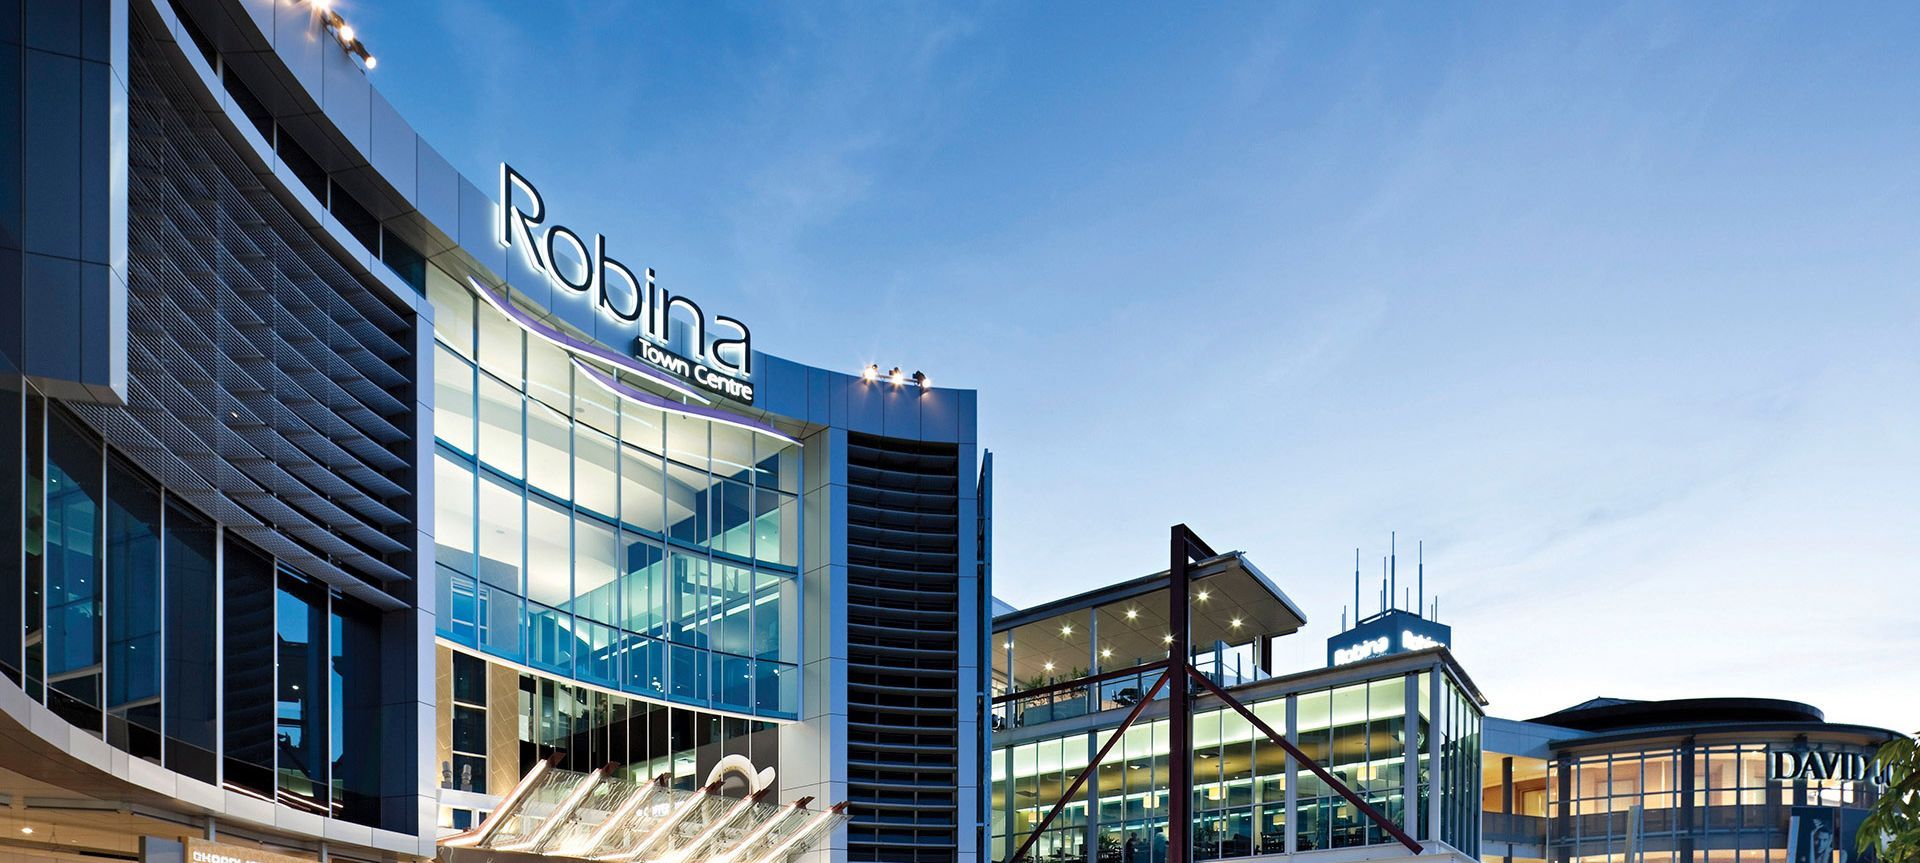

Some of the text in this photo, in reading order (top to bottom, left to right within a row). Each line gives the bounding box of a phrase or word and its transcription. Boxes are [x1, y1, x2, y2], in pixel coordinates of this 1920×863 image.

[499, 162, 751, 377] Robina
[638, 337, 753, 400] Town Centre
[1770, 750, 1867, 780] DAVID
